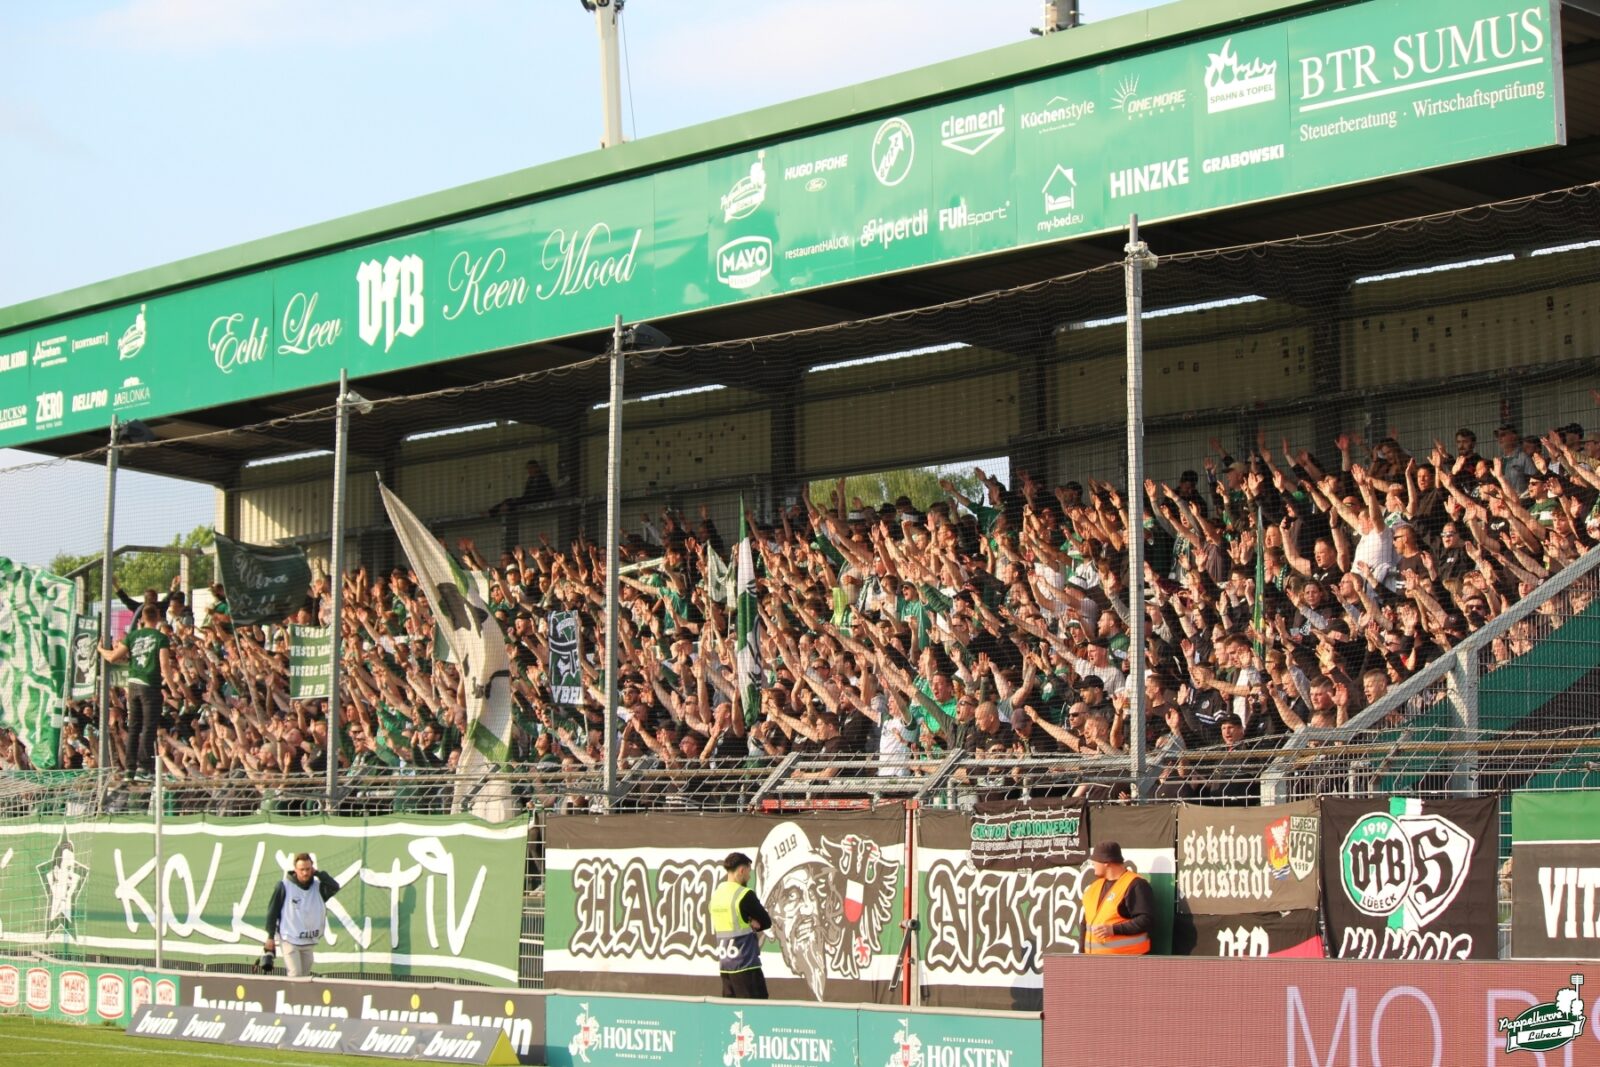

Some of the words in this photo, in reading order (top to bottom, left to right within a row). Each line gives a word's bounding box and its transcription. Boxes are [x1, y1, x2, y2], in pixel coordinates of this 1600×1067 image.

[1299, 45, 1381, 100] BTR
[1393, 7, 1543, 80] SUMUS
[1128, 97, 1152, 113] ONE
[1153, 89, 1186, 108] MORE
[1210, 88, 1237, 104] SPAHN
[1247, 84, 1273, 96] TOPEL
[941, 104, 1005, 138] clement
[1021, 100, 1094, 129] Küchenstyle
[1299, 110, 1397, 142] Steuerberatung
[1413, 80, 1545, 118] Wirtschaftsprüfung
[785, 161, 812, 180] HUGO
[814, 154, 848, 173] PFOHE
[1202, 144, 1284, 173] GRABOWSKI
[1110, 157, 1189, 199] HINZKE
[443, 247, 529, 320] Keen
[536, 222, 642, 300] Mood
[723, 245, 767, 273] MAYO
[208, 313, 268, 374] Echt
[277, 292, 342, 355] Leev
[113, 387, 150, 406] JABLONKA
[1362, 822, 1391, 837] 1919
[774, 833, 798, 860] 1919
[1183, 825, 1263, 867] sektion
[1290, 832, 1316, 862] VfB
[1178, 861, 1273, 899] neustadt
[114, 837, 487, 955] KOLLKTIV
[1362, 893, 1397, 909] LÜBECK
[1538, 867, 1600, 938] VIT
[136, 1010, 178, 1035] bwin
[182, 1014, 225, 1039] bwin
[238, 1017, 286, 1044] bwin
[292, 1022, 342, 1049] bwin
[360, 1026, 415, 1054] bwin
[423, 1030, 481, 1058] bwin
[603, 1026, 673, 1052] HOLSTEN
[759, 1035, 830, 1062] HOLSTEN
[927, 1045, 1010, 1067] HOLSTEN
